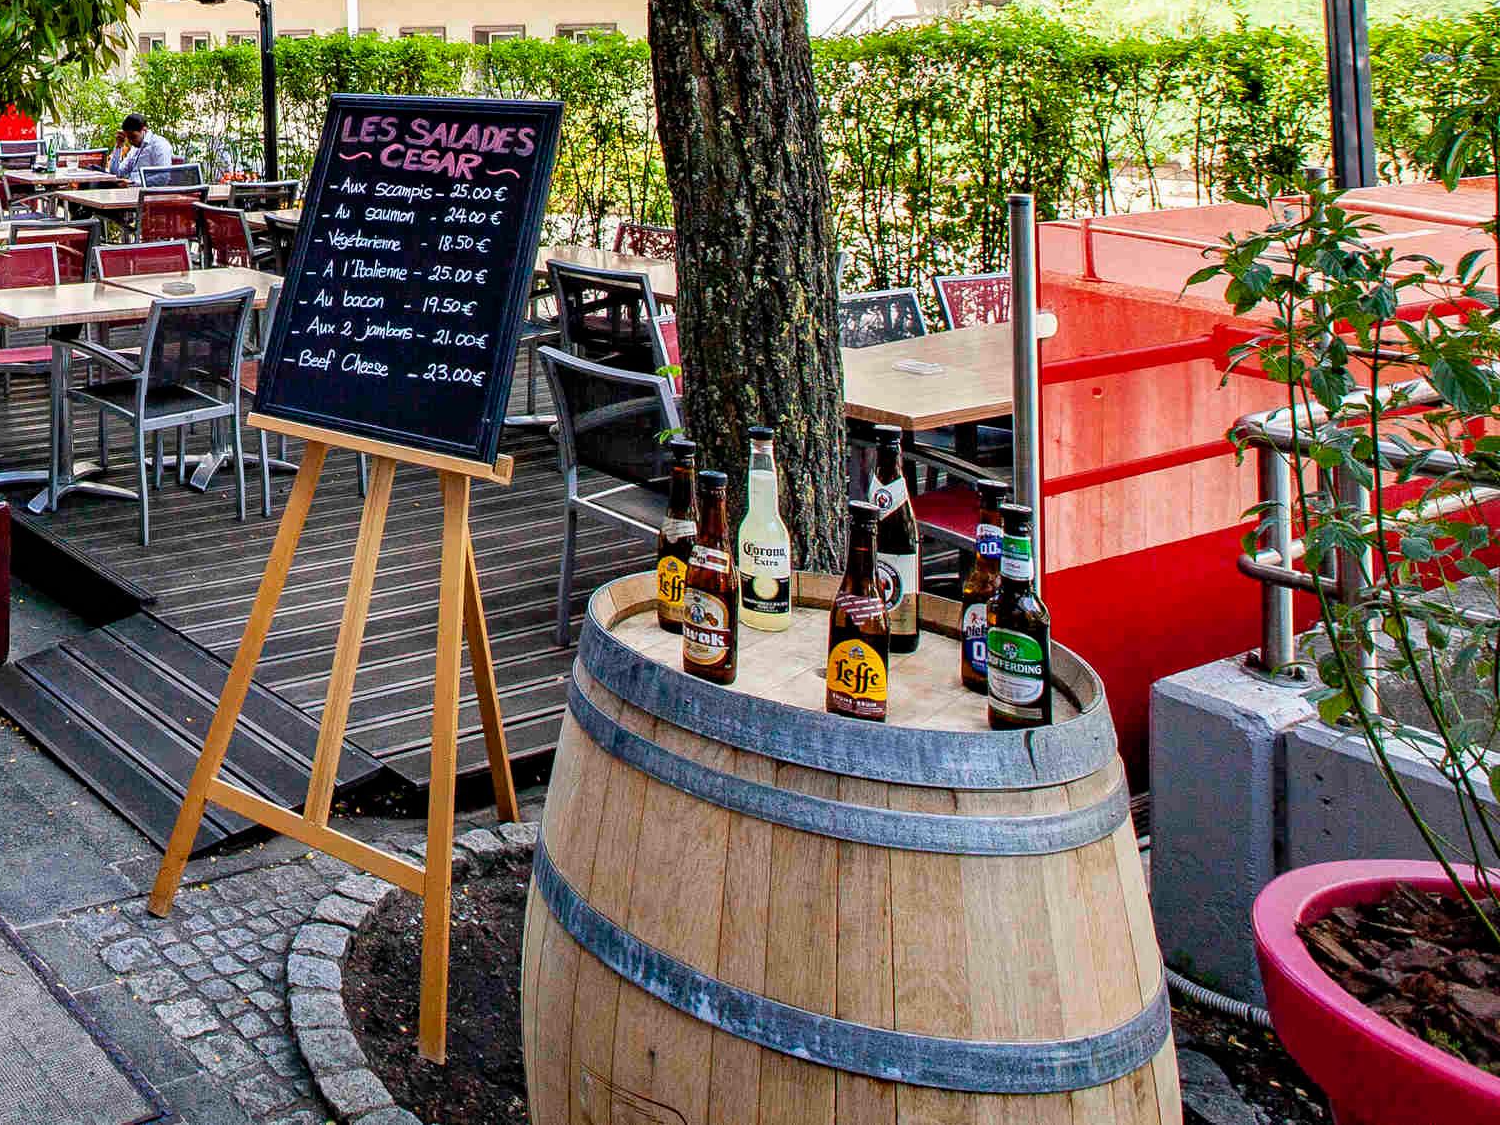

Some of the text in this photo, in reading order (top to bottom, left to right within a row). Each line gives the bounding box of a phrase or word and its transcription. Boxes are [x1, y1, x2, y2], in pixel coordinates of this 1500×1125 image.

[341, 115, 537, 157] LES SALADES
[379, 143, 484, 180] CESAR
[341, 177, 368, 194] Aux
[334, 204, 351, 219] Au
[364, 207, 415, 223] saumon
[313, 288, 333, 308] Au
[343, 290, 385, 309] bacon
[305, 315, 336, 335] Aux
[340, 321, 353, 336] 2
[354, 318, 414, 342] jambons
[299, 348, 336, 371] Beef
[341, 353, 389, 377] Cheese
[742, 540, 787, 557] Corona
[754, 558, 779, 567] Extra
[659, 572, 685, 603] Leff
[835, 658, 880, 694] Leffe
